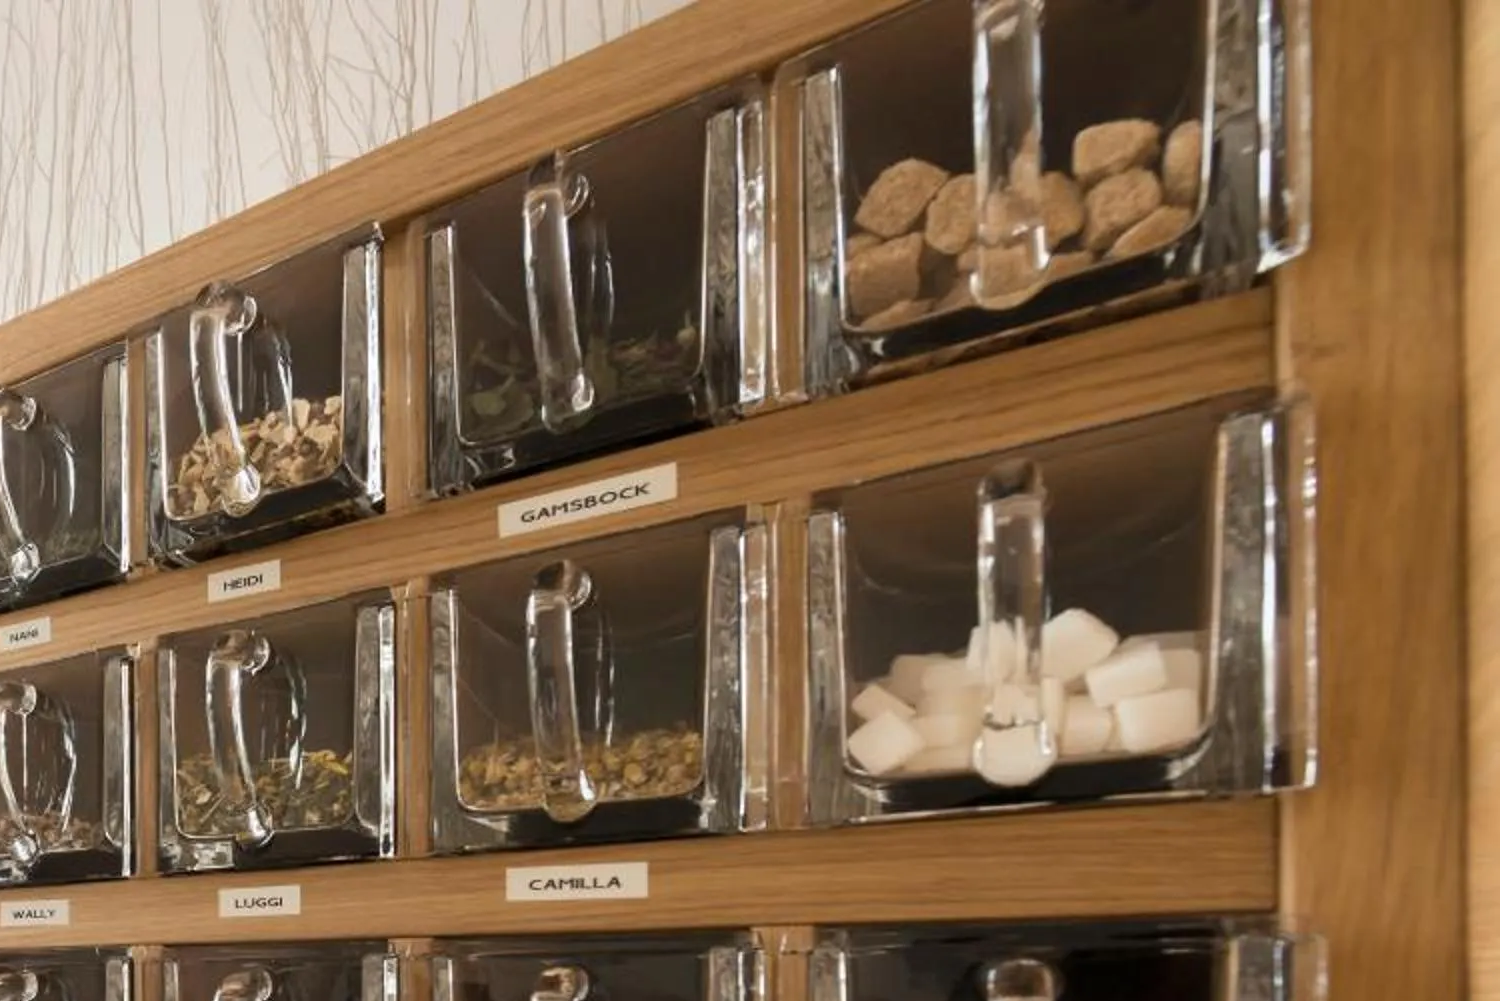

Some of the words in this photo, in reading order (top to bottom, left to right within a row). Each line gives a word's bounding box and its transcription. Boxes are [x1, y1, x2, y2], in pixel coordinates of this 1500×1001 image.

[521, 483, 650, 524] GAMSBOCK
[223, 573, 263, 591] HEIDI
[9, 628, 39, 642] NANI
[528, 875, 622, 891] CAMILLA
[235, 896, 283, 909] LUGGI
[13, 908, 55, 920] WALLY
